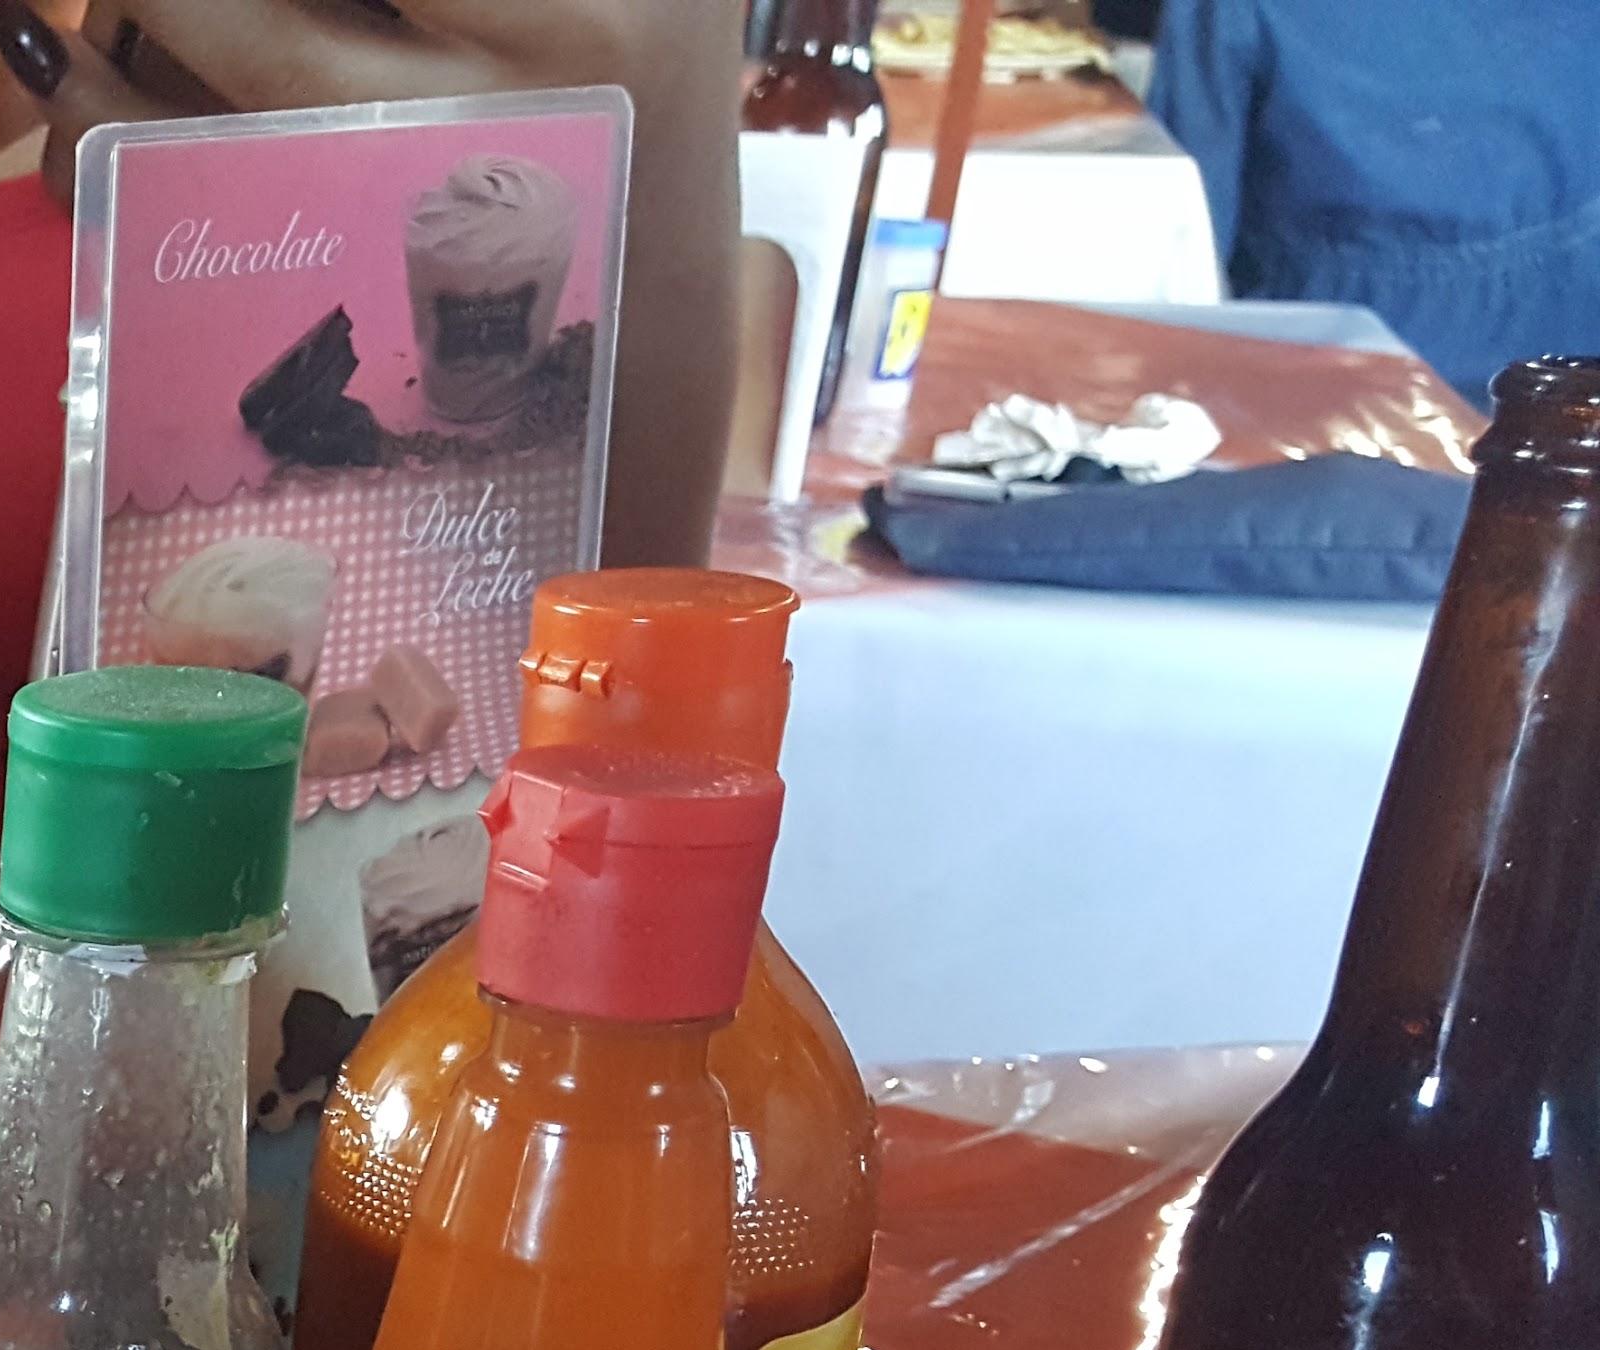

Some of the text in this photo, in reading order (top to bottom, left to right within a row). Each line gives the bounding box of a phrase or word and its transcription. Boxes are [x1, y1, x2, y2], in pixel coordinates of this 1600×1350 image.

[155, 210, 346, 283] Chocolate
[400, 483, 516, 553] Dulce
[418, 546, 534, 628] Leche
[483, 546, 502, 567] de
